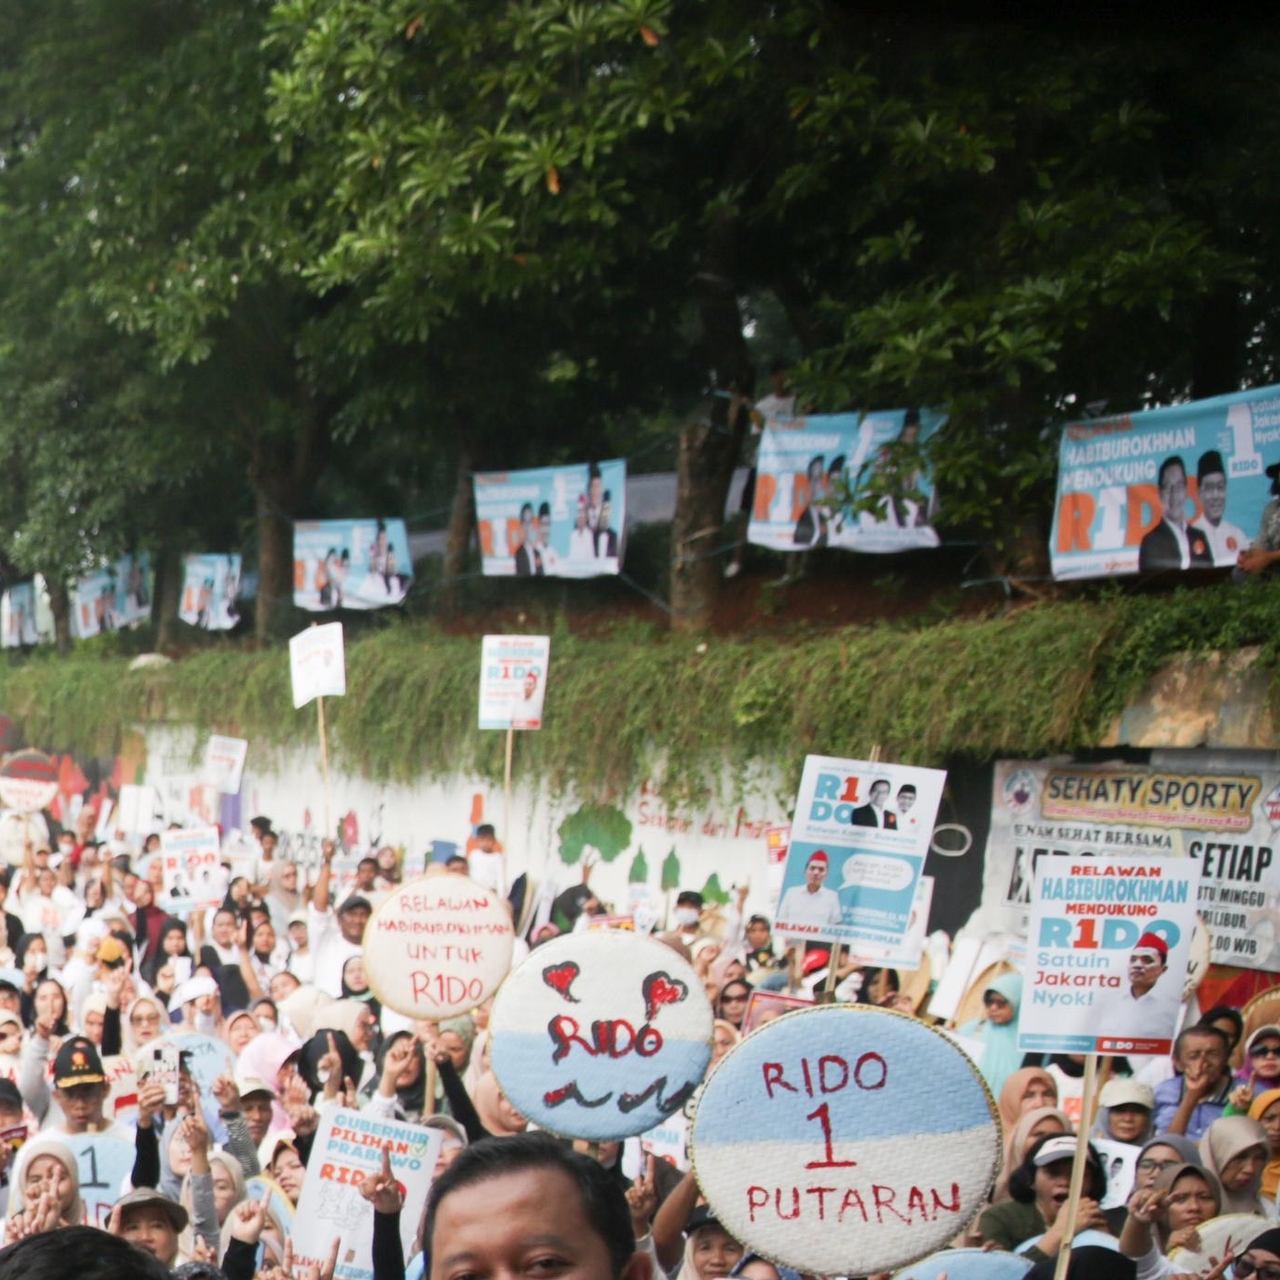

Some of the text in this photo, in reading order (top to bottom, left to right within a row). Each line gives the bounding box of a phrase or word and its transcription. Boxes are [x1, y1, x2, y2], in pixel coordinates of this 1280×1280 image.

[1067, 427, 1197, 467] HABIBUROKHMAN
[1062, 458, 1158, 492] MENDUKUNG
[814, 773, 860, 804] R1
[1048, 776, 1256, 810] SEHATY SPORTY
[1058, 826, 1100, 842] SEHAT
[1103, 829, 1173, 850] BERSAMA
[1070, 866, 1162, 877] RELAWAN
[399, 895, 491, 914] RELAWAN
[1041, 878, 1189, 904] HABIBUROKHMAN
[1220, 887, 1266, 908] MINGGU
[1065, 903, 1159, 917] MENDUKUNG
[407, 942, 484, 964] UNTUK
[1037, 952, 1110, 969] Satuin
[1034, 970, 1121, 988] Jakarta
[1032, 989, 1095, 1008] Nyok!
[550, 1015, 664, 1064] RIDO
[762, 1051, 888, 1099] RIDO
[330, 1127, 409, 1155] PILIHAN
[334, 1114, 430, 1144] GUBERNUR
[804, 1102, 857, 1169] 1
[747, 1183, 961, 1225] PUTARAN
